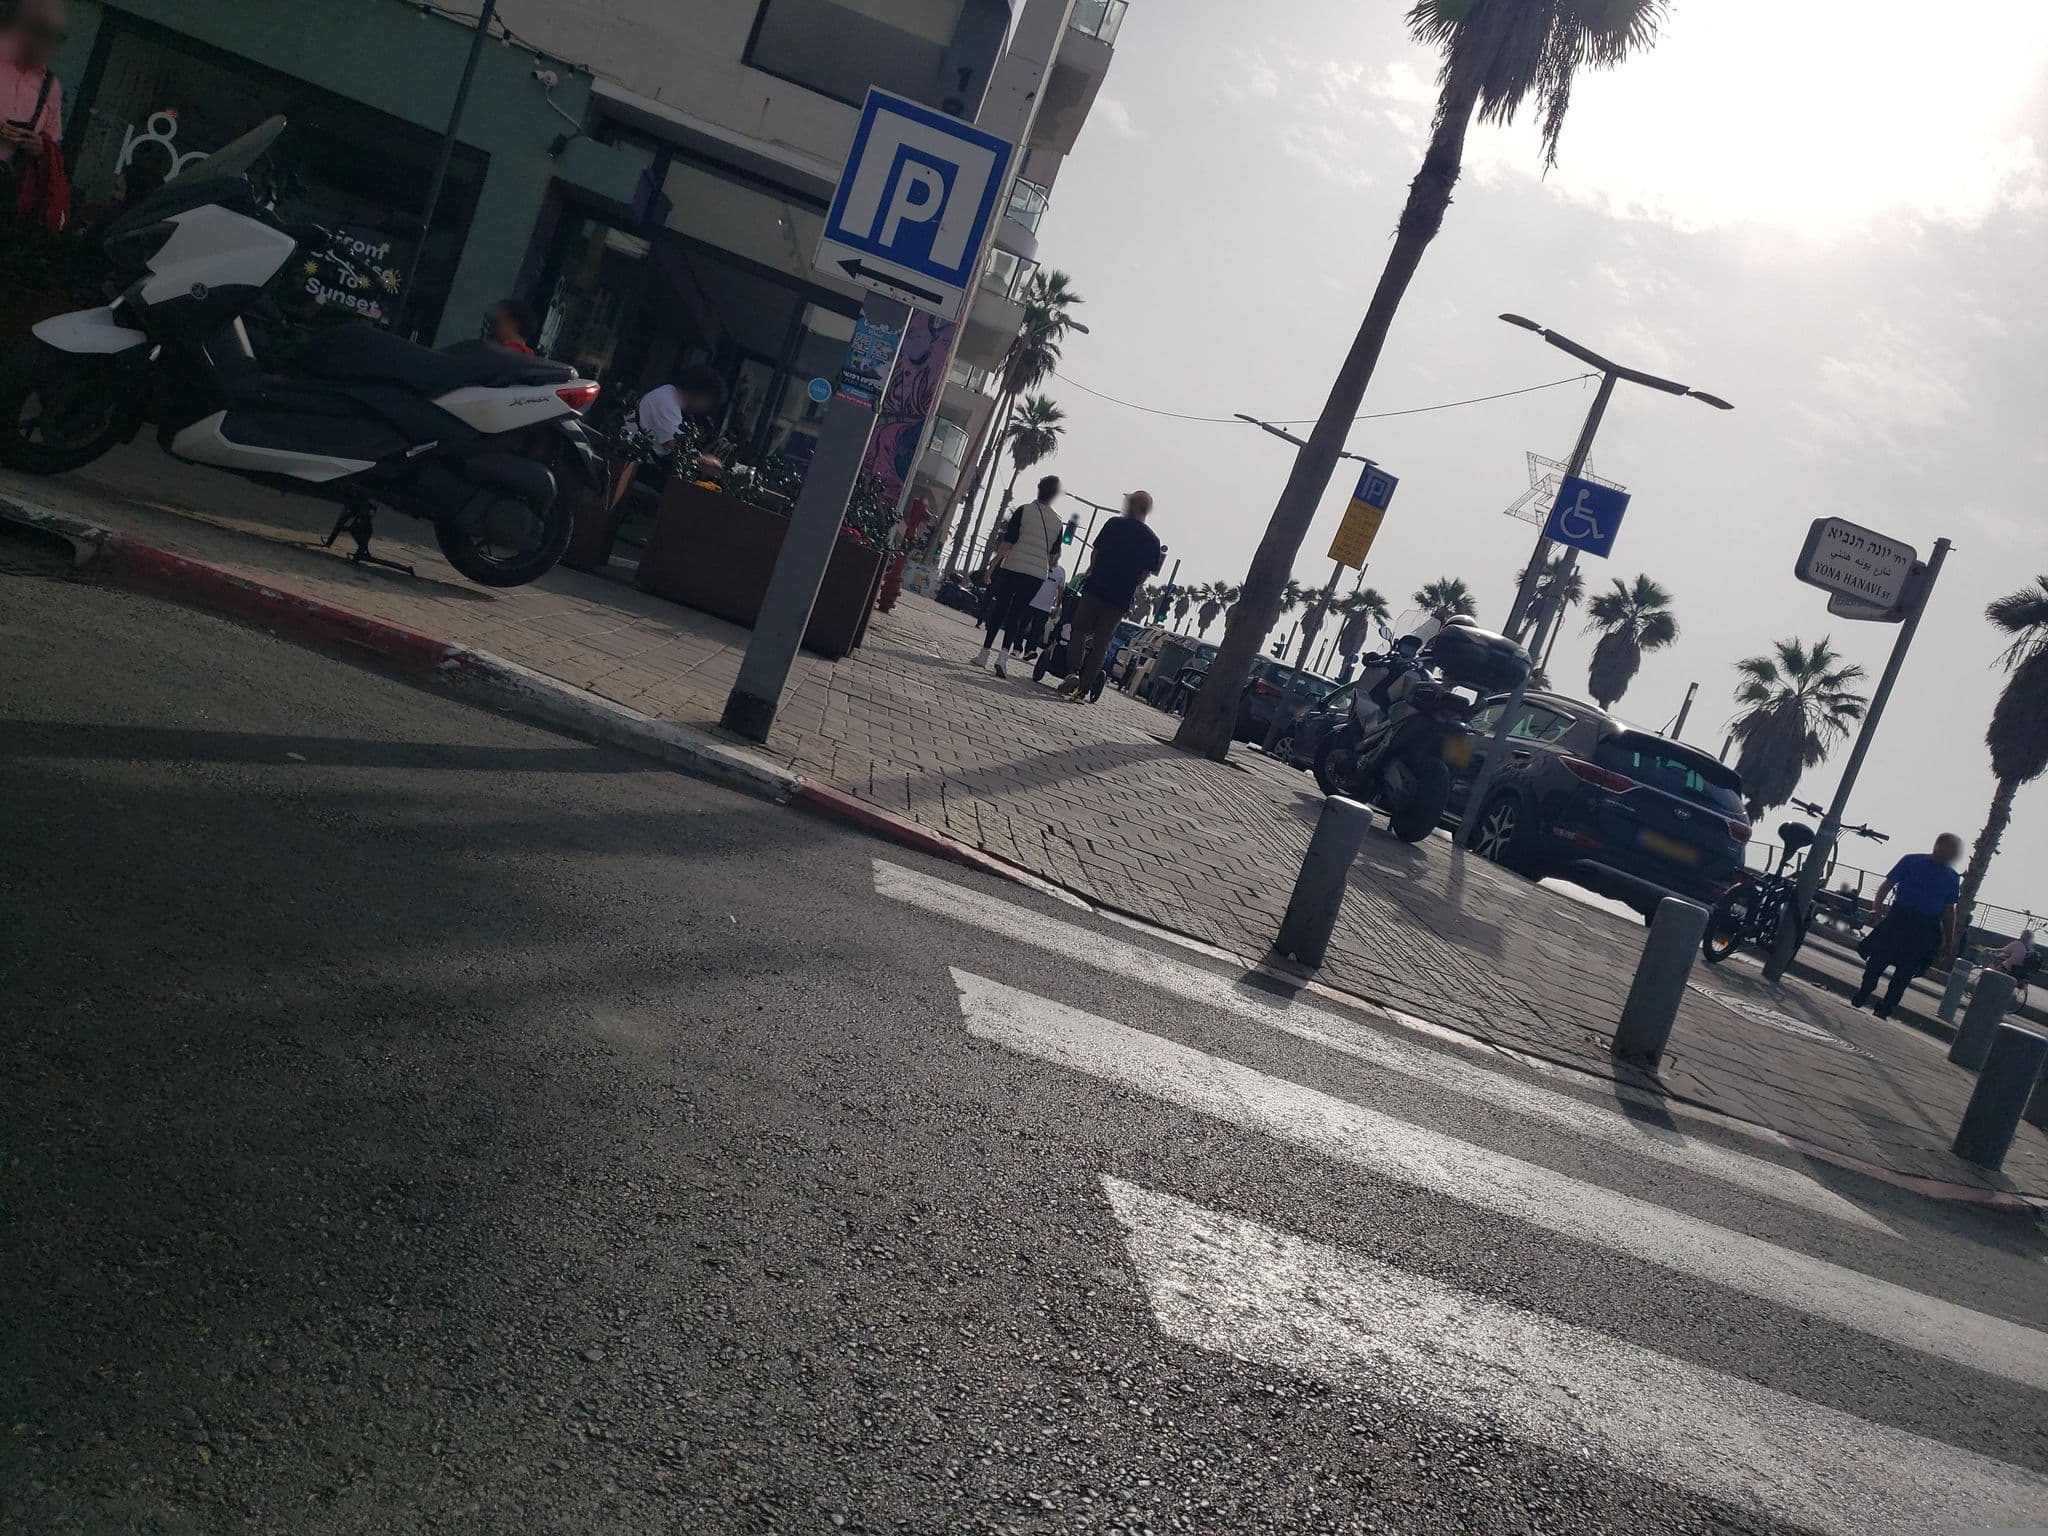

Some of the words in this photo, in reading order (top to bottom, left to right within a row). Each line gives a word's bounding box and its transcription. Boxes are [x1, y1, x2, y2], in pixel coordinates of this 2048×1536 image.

[879, 158, 944, 248] P
[338, 267, 358, 289] To
[304, 276, 379, 312] Sunset
[1365, 477, 1387, 500] P
[1827, 526, 1865, 549] הנביא
[1866, 540, 1892, 558] יונה
[1815, 561, 1841, 580] YONA
[1842, 574, 1882, 596] HANAVI
